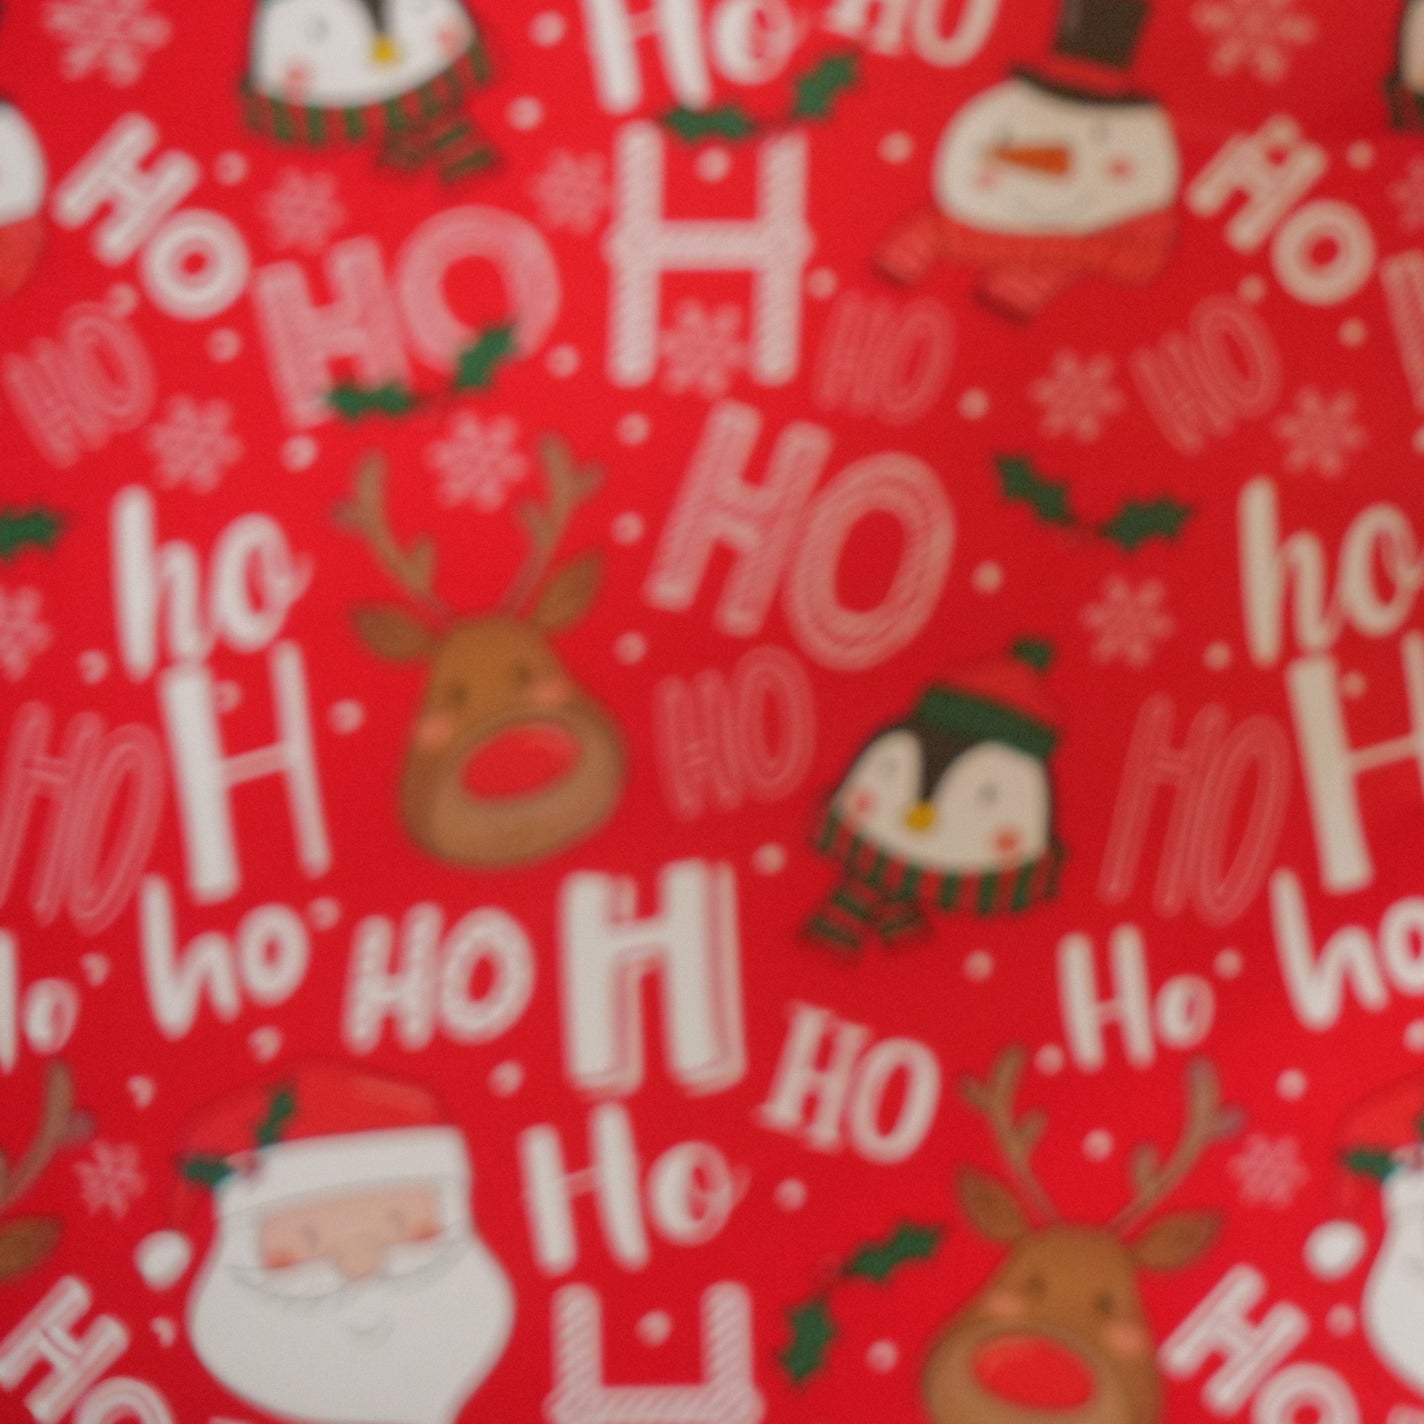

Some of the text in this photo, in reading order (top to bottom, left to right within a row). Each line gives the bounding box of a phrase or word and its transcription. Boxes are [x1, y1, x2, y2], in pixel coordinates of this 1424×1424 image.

[52, 113, 250, 321] HO
[606, 120, 816, 387] H
[1185, 114, 1377, 306] HO
[3, 301, 155, 458] HO
[253, 204, 563, 428] HO
[813, 291, 956, 426] HO
[1130, 292, 1283, 456] HO
[111, 483, 313, 682] ho
[644, 400, 956, 671] HO
[160, 638, 332, 904] H
[655, 646, 815, 821] HO
[1100, 694, 1291, 926] HO
[0, 928, 78, 1071] o
[138, 874, 309, 1040] ho
[341, 902, 535, 1054] HO
[559, 859, 747, 1098] H
[1054, 923, 1215, 1073] Ho
[752, 1000, 941, 1166] HO
[517, 1101, 751, 1277] Ho
